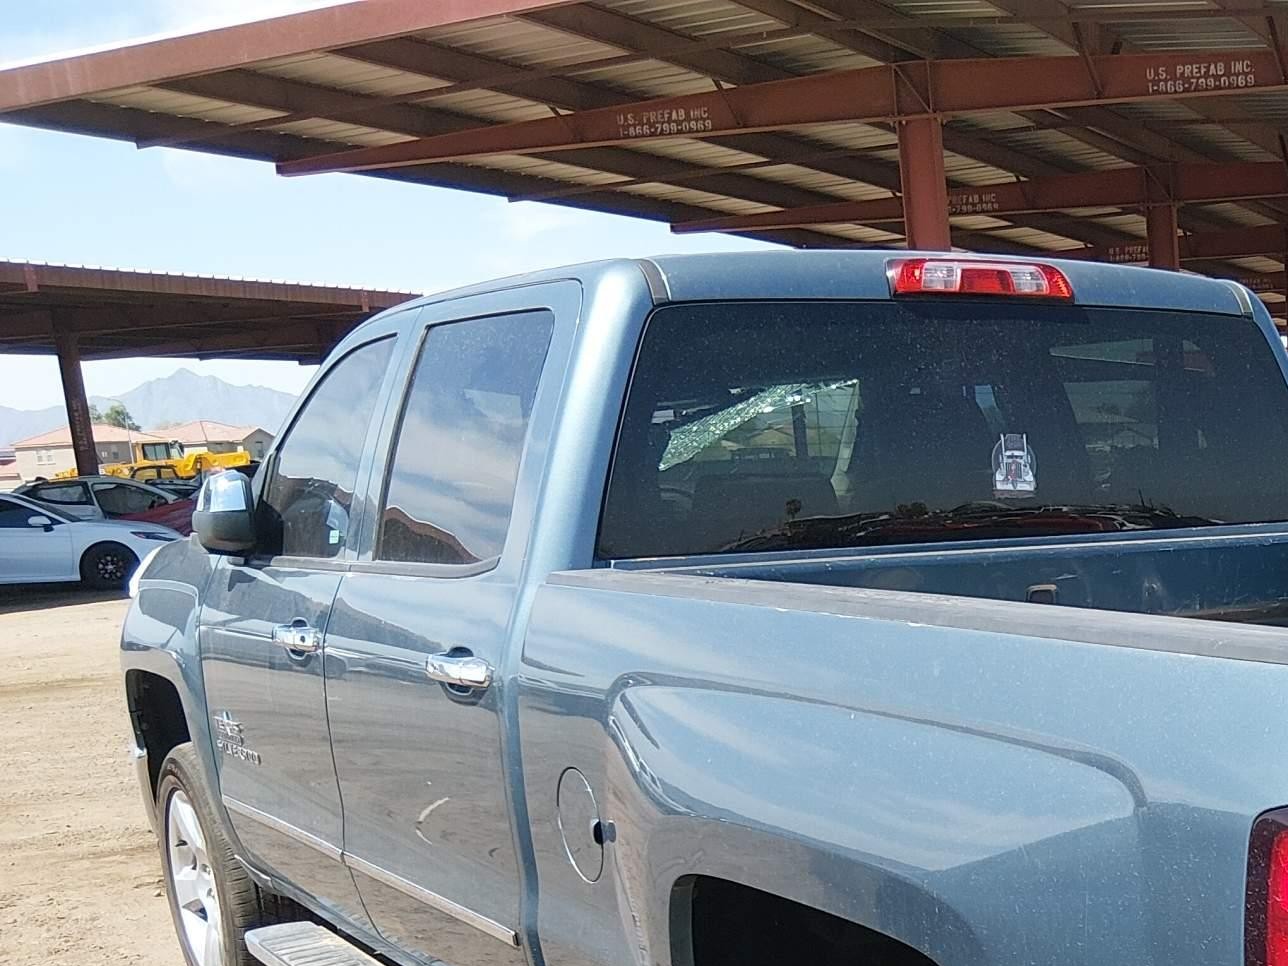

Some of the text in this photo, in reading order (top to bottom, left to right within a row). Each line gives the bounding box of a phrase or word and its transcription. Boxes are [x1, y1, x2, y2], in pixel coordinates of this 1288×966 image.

[1146, 60, 1255, 80] U.S. PREFAB INC.
[1148, 74, 1255, 93] 1-866-799-0969
[616, 112, 639, 125] U.S.
[642, 108, 686, 123] PREFAB
[619, 119, 712, 137] 1-866-799-0969
